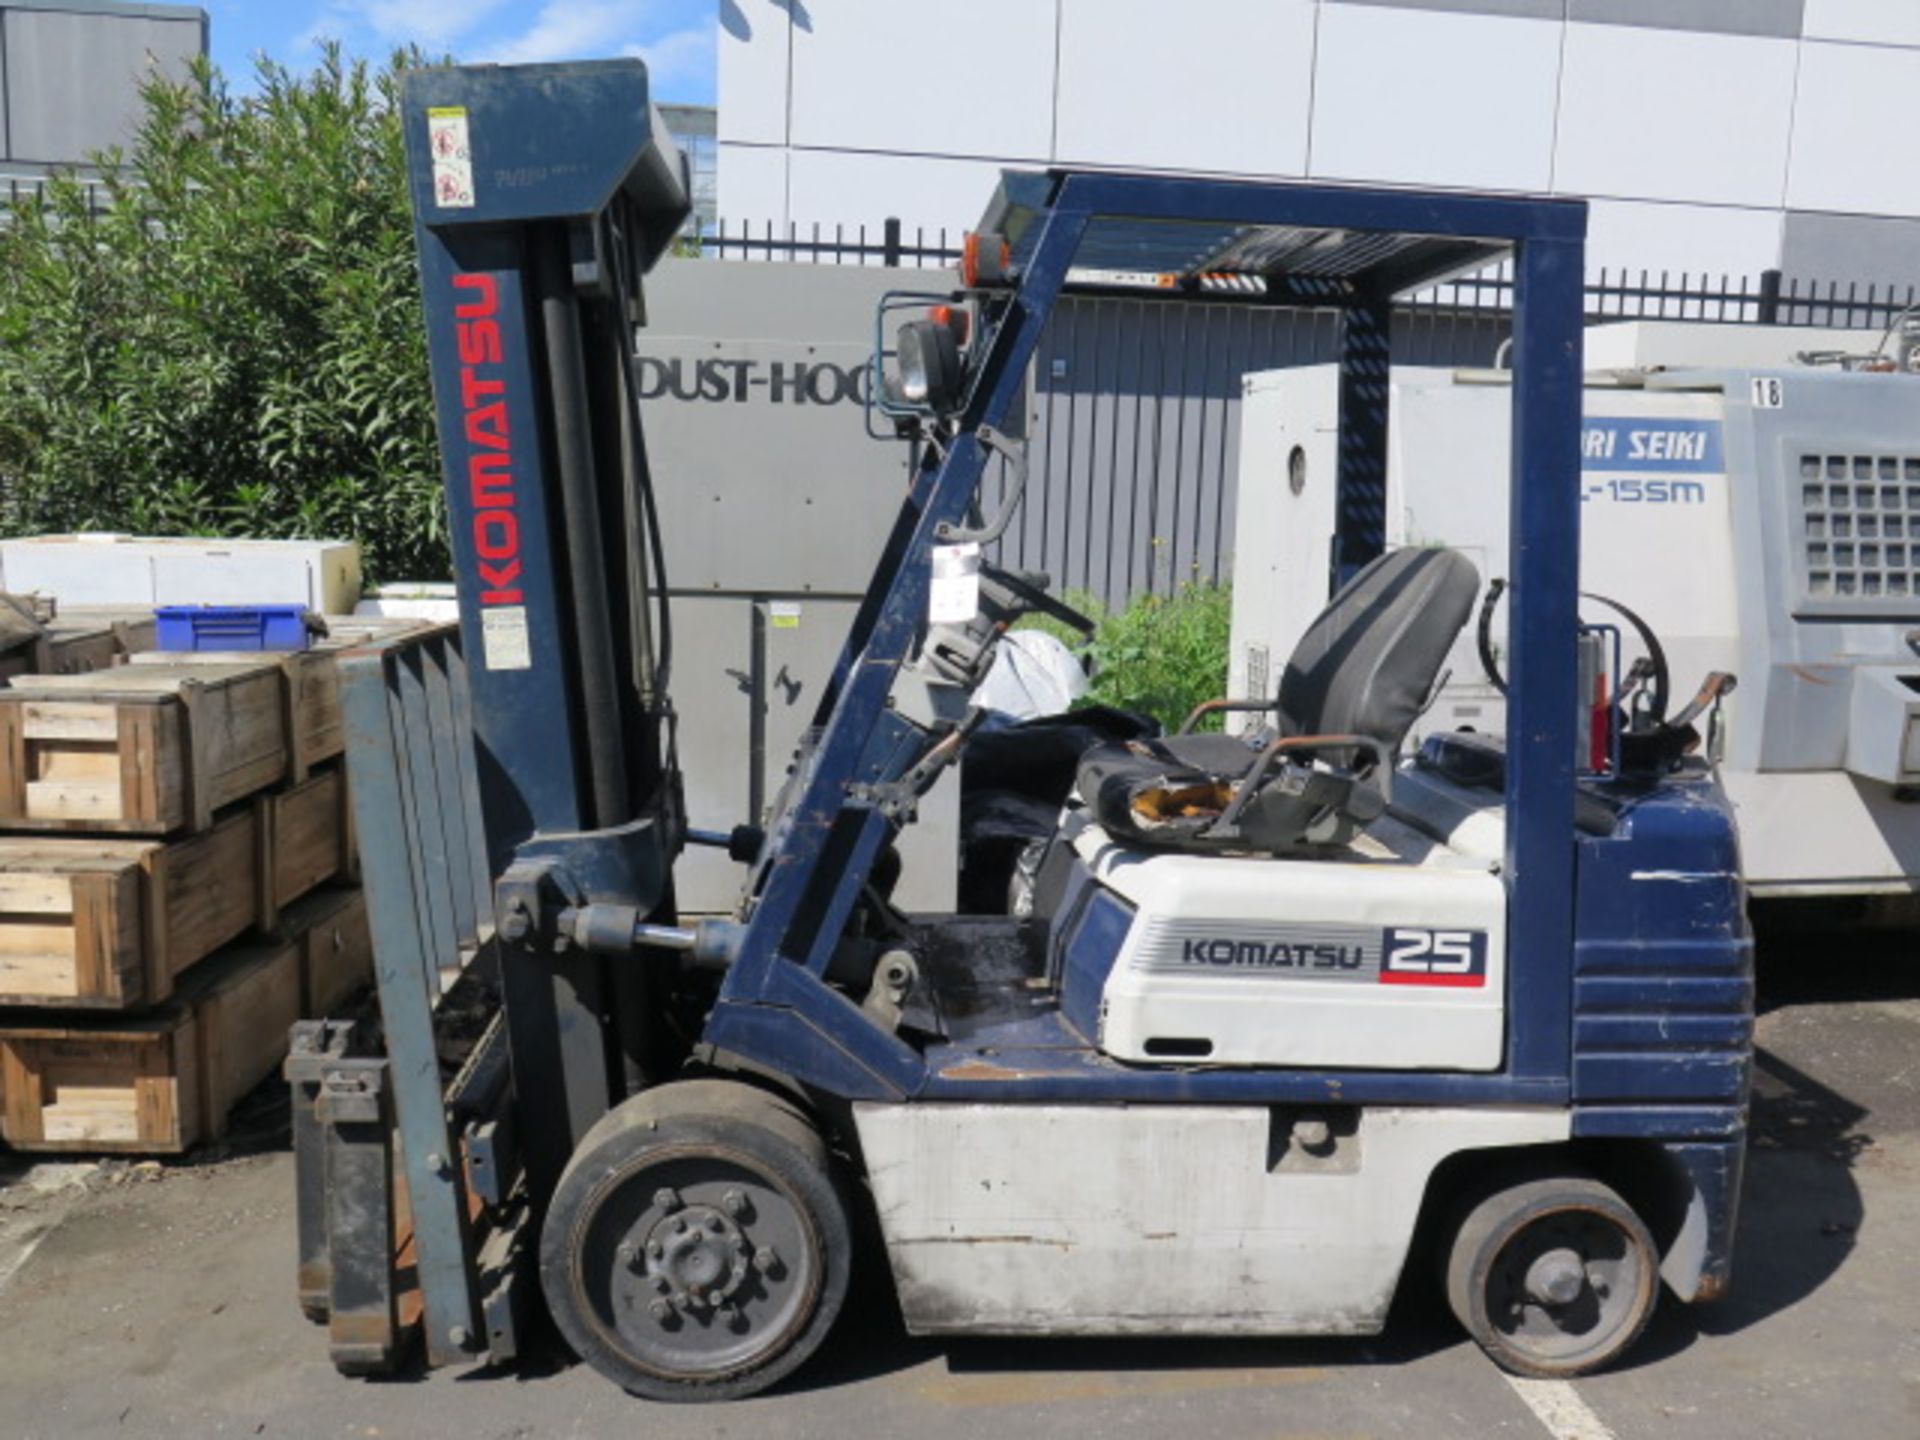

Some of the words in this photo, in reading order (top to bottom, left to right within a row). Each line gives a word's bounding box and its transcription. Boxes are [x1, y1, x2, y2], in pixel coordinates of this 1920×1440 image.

[452, 272, 525, 605] KOMATSU
[1581, 428, 1617, 459] RI
[1627, 429, 1707, 461] SEIKI
[1581, 479, 1706, 503] -15SM
[1182, 938, 1363, 970] KOMATSU
[1388, 929, 1472, 974] 25
